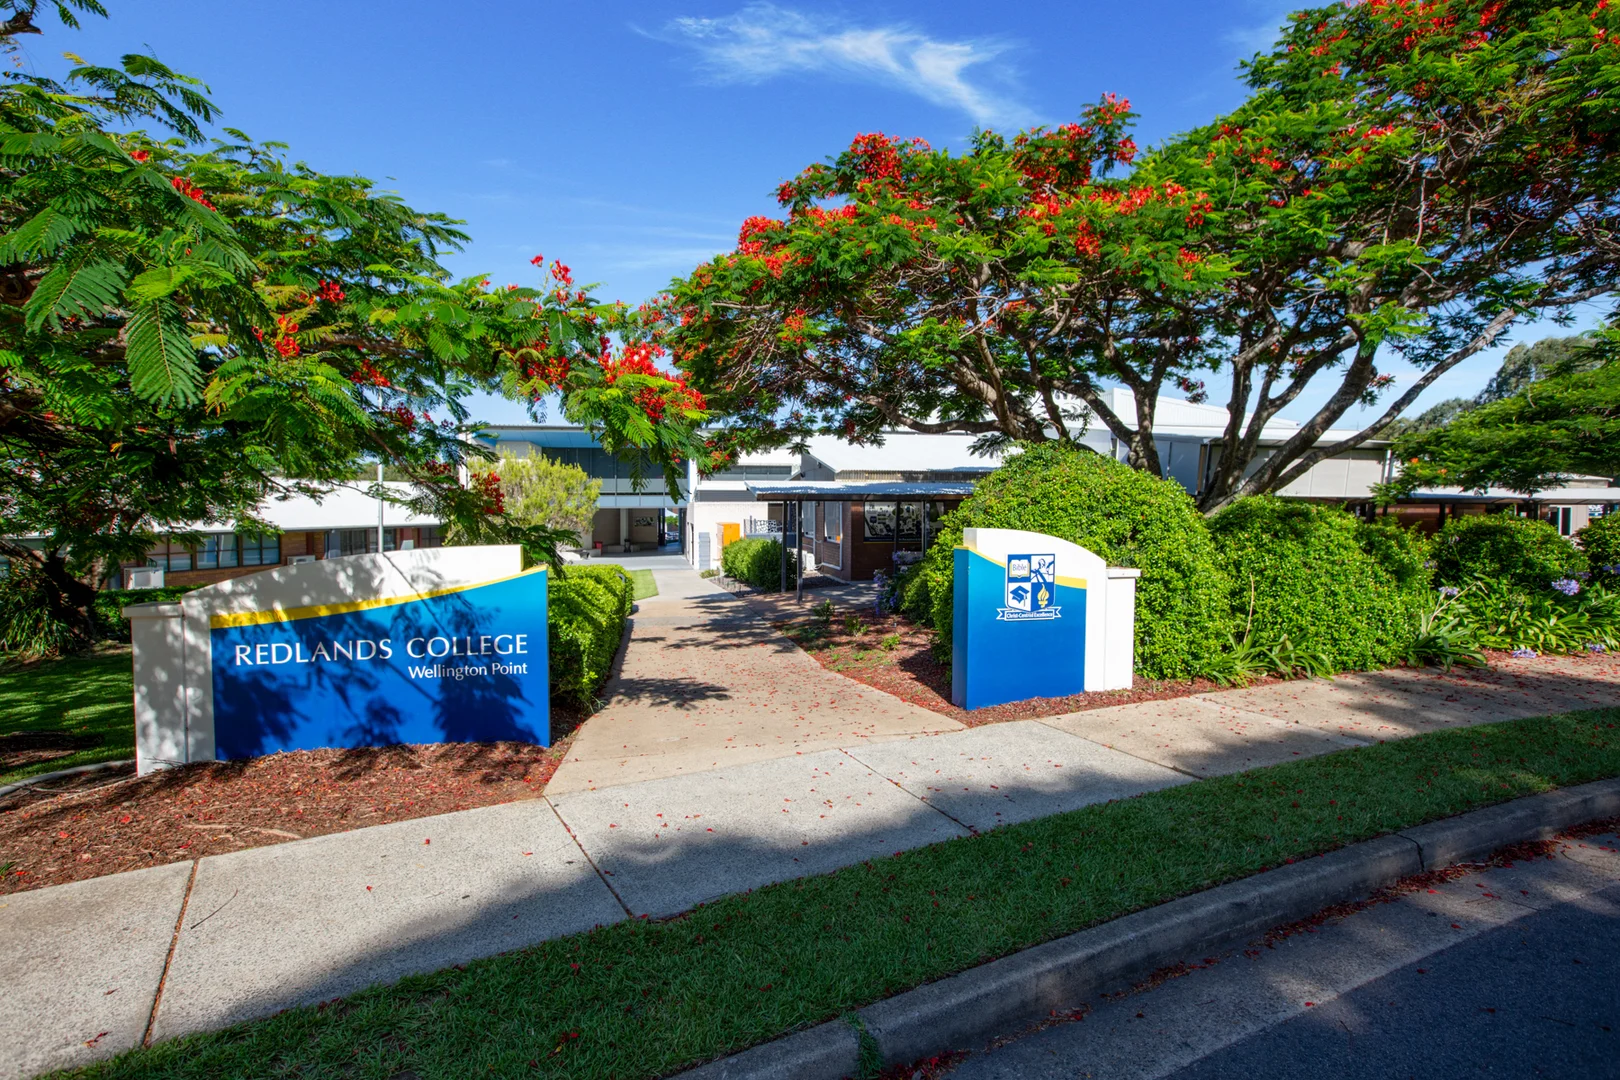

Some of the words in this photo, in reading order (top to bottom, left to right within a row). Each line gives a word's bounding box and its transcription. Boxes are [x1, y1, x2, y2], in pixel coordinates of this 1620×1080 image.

[235, 639, 393, 666] REDLANDS
[406, 634, 528, 659] COLLEGE
[408, 664, 487, 680] Wellington
[491, 662, 528, 675] Point
